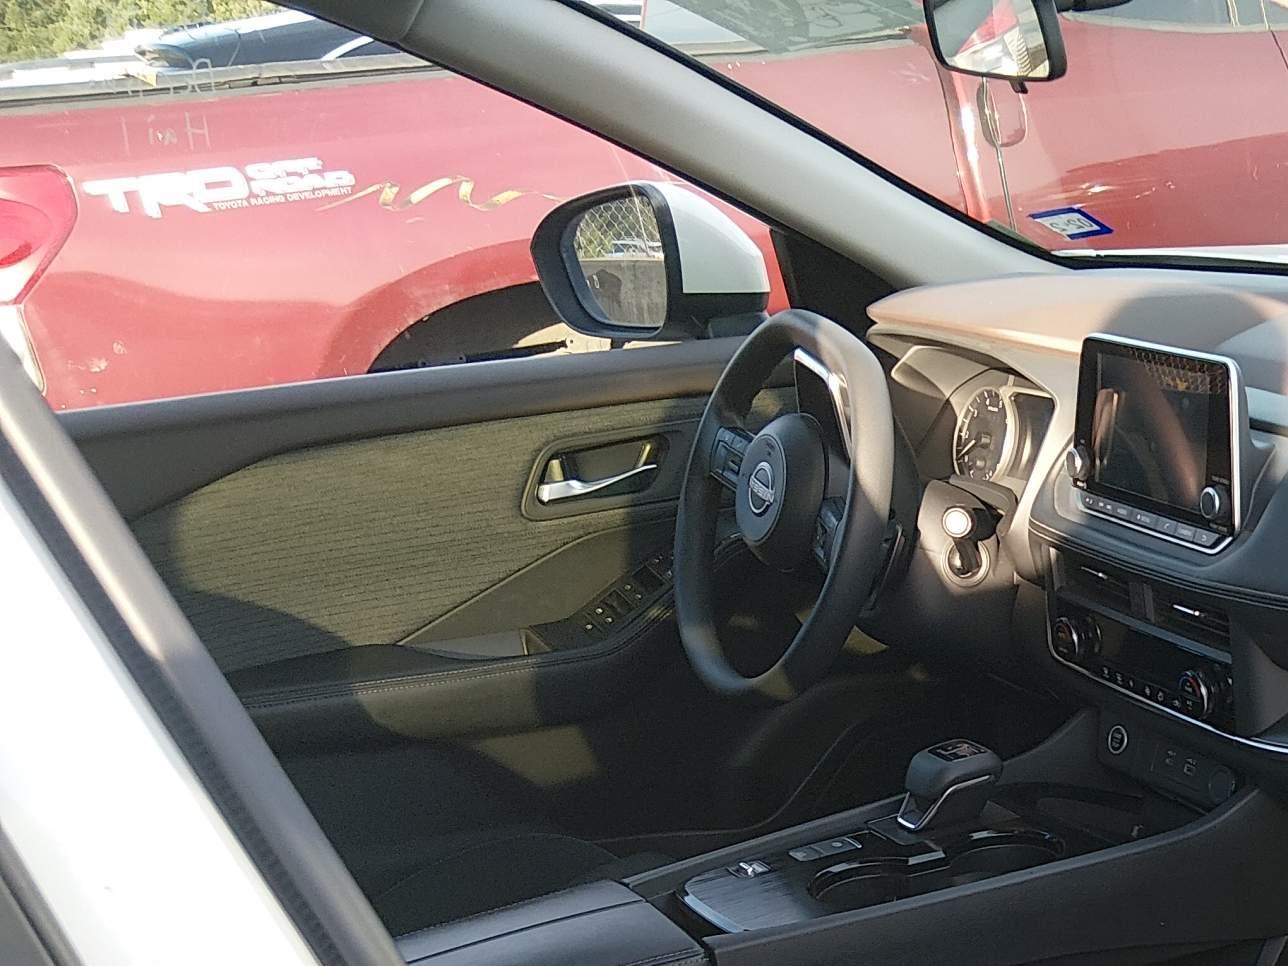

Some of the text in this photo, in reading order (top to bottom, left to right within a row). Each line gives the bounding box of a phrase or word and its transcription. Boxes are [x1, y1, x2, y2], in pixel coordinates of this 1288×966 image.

[82, 166, 250, 218] TRD
[212, 186, 353, 211] TOYOTA RACING DEVELOPMENT
